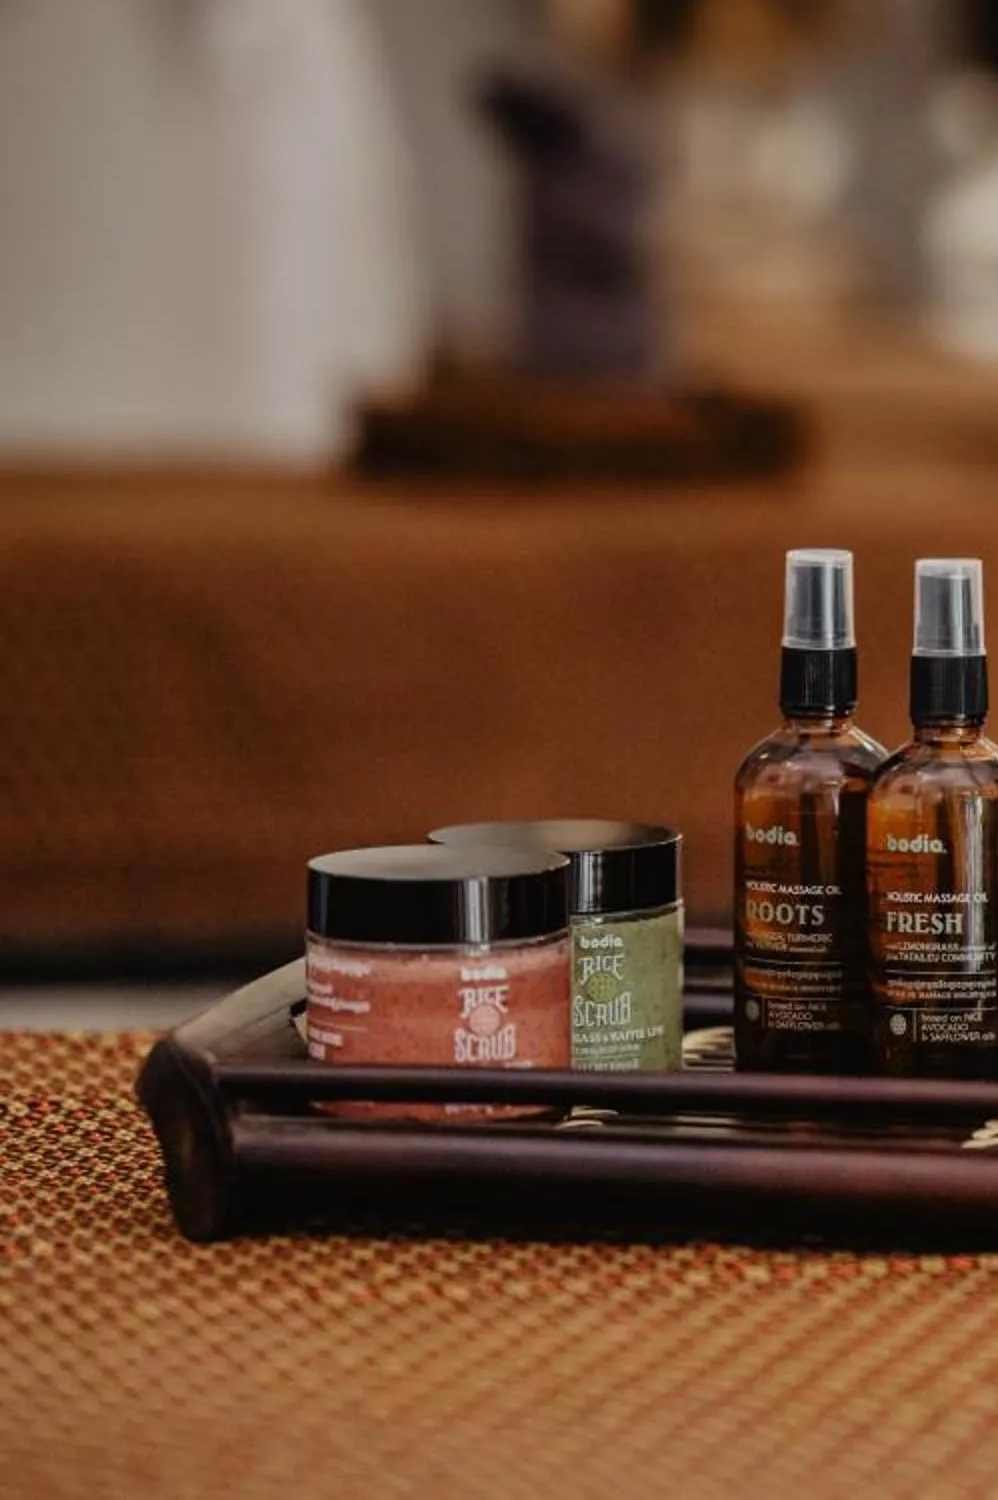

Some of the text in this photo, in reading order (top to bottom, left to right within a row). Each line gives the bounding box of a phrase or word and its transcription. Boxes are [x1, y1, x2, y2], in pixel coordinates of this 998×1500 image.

[778, 884, 824, 895] MASSAGE
[886, 891, 988, 904] HOLISTIC MASSAGE OIL
[746, 900, 825, 926] ROOTS
[886, 911, 964, 935] FRESH
[576, 953, 626, 987] RICE
[457, 984, 511, 1020] RICE
[574, 991, 633, 1028] SCRUB
[453, 1023, 518, 1063] SCRUB
